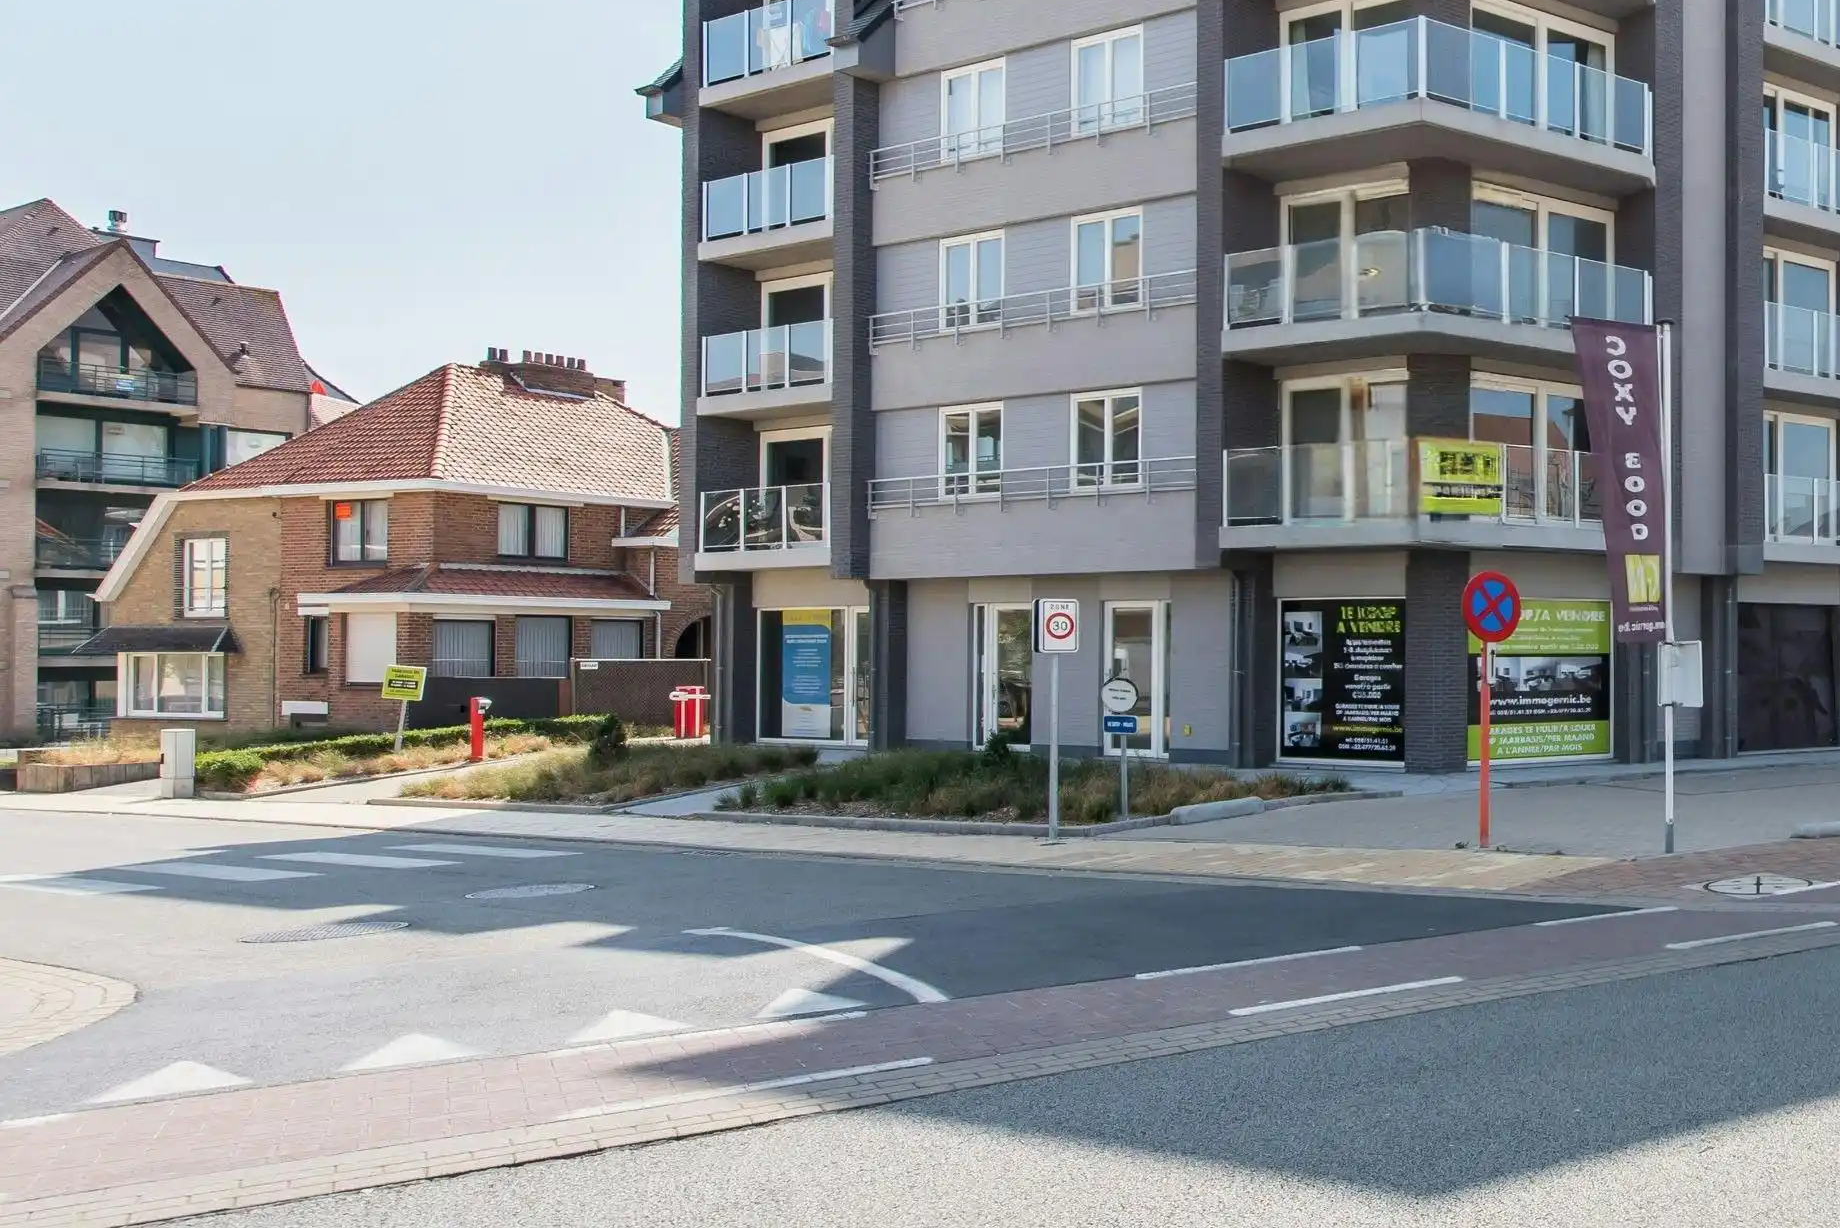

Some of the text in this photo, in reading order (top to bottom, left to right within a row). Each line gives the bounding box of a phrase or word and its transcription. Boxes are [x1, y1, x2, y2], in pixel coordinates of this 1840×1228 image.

[1050, 603, 1070, 611] ZONE
[1556, 610, 1606, 622] VENDRE
[1052, 620, 1068, 632] 30
[1490, 694, 1592, 707] www.immogernic.be
[1563, 733, 1595, 742] MAAND
[1561, 743, 1583, 752] MOIS
